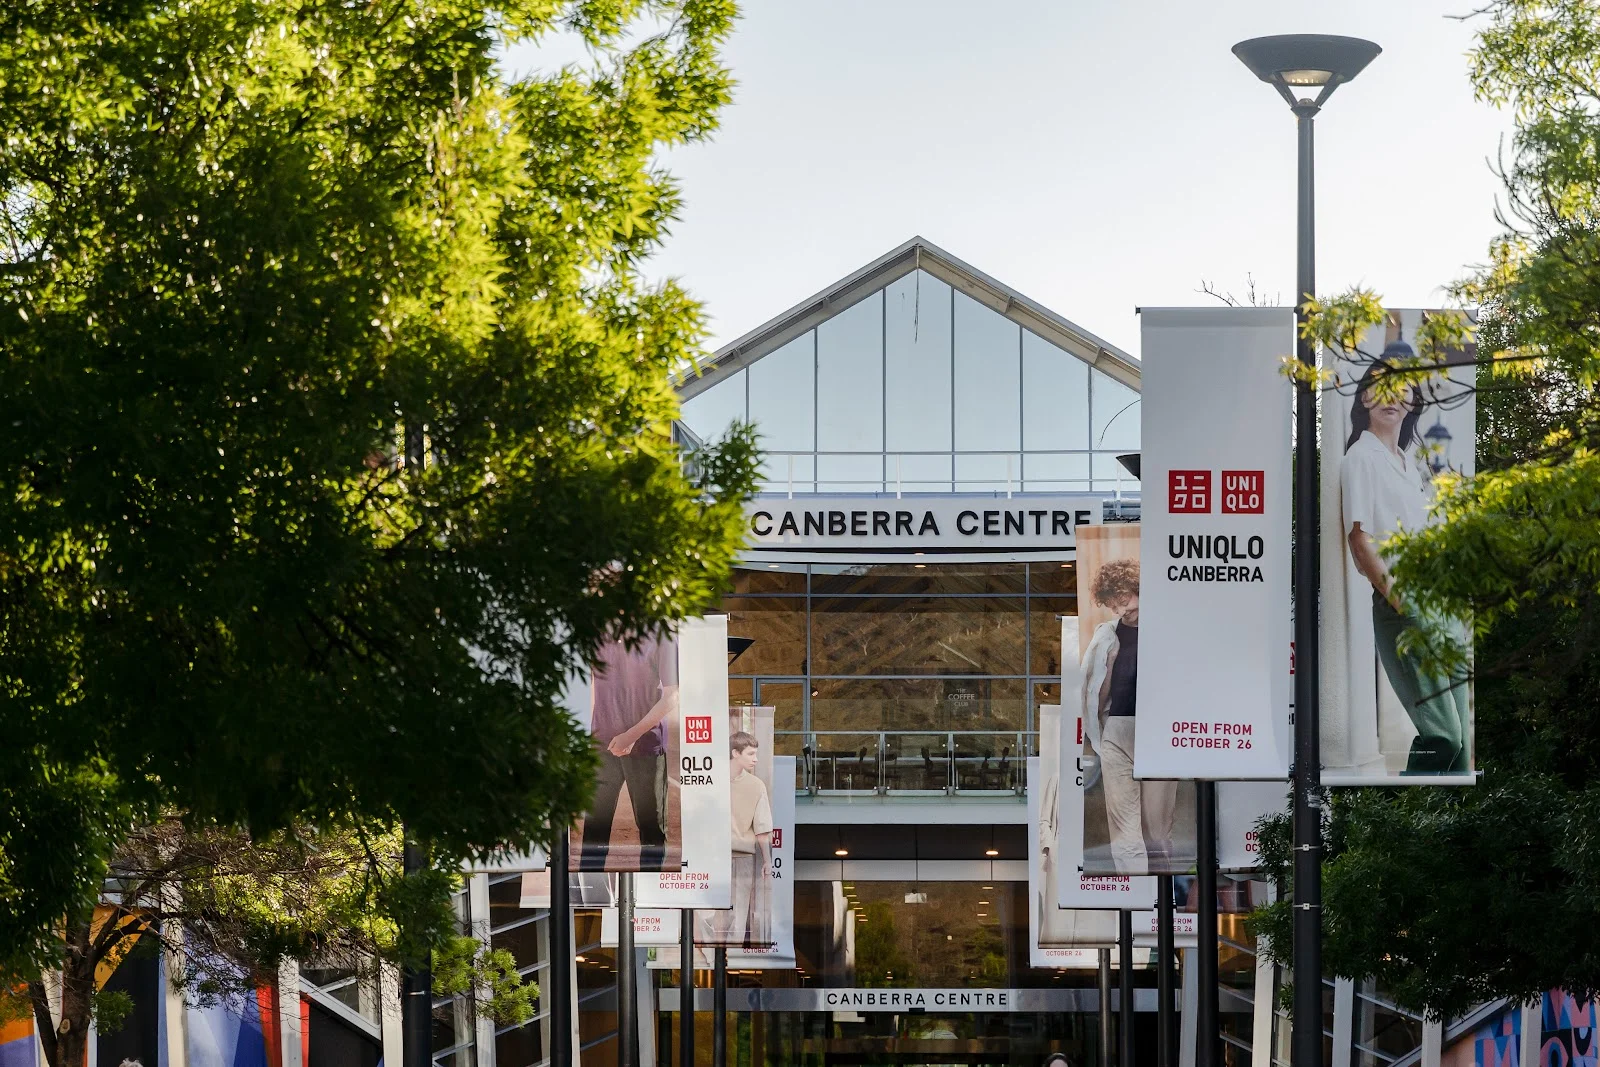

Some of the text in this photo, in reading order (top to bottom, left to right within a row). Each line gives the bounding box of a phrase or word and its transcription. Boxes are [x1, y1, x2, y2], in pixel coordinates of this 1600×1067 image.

[1226, 475, 1257, 491] UNI
[1226, 494, 1260, 511] QLO
[750, 510, 1091, 537] CANBERRA CENTRE
[1168, 534, 1264, 564] UNIQLO
[1167, 565, 1264, 583] CANBERRA
[688, 719, 708, 729] UNI
[1172, 721, 1252, 736] OPEN FROM
[688, 730, 710, 742] QLO
[1171, 736, 1252, 750] OCTOBER 26
[681, 756, 713, 773] QLO
[659, 873, 709, 881] OPEN FROM
[659, 882, 709, 890] OCTOBER 26
[1080, 883, 1130, 892] OCTOBER 26
[641, 917, 661, 925] FROM
[826, 993, 1008, 1006] CANBERRA CENTRE
